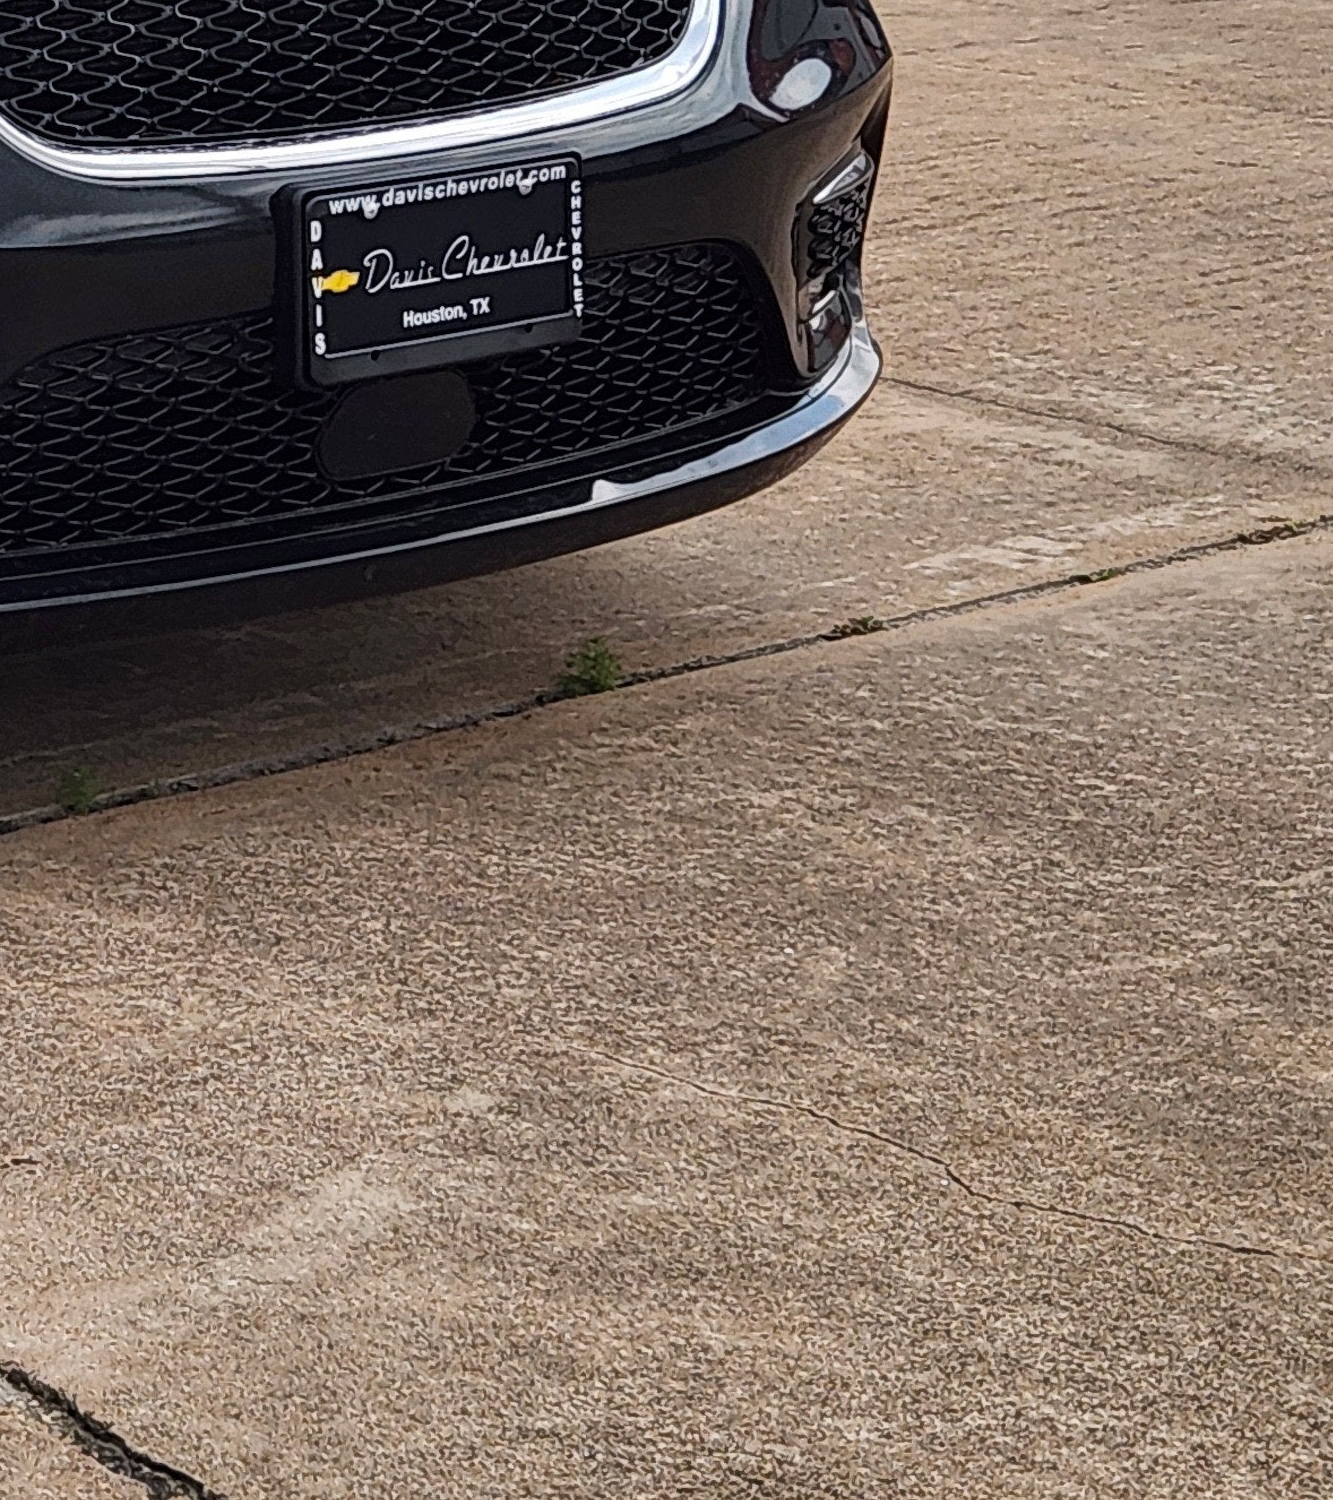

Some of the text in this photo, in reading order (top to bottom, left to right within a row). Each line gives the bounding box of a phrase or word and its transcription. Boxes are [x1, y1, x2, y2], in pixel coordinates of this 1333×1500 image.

[363, 233, 569, 294] Davis Chevrolet
[403, 297, 491, 328] Houston, TX
